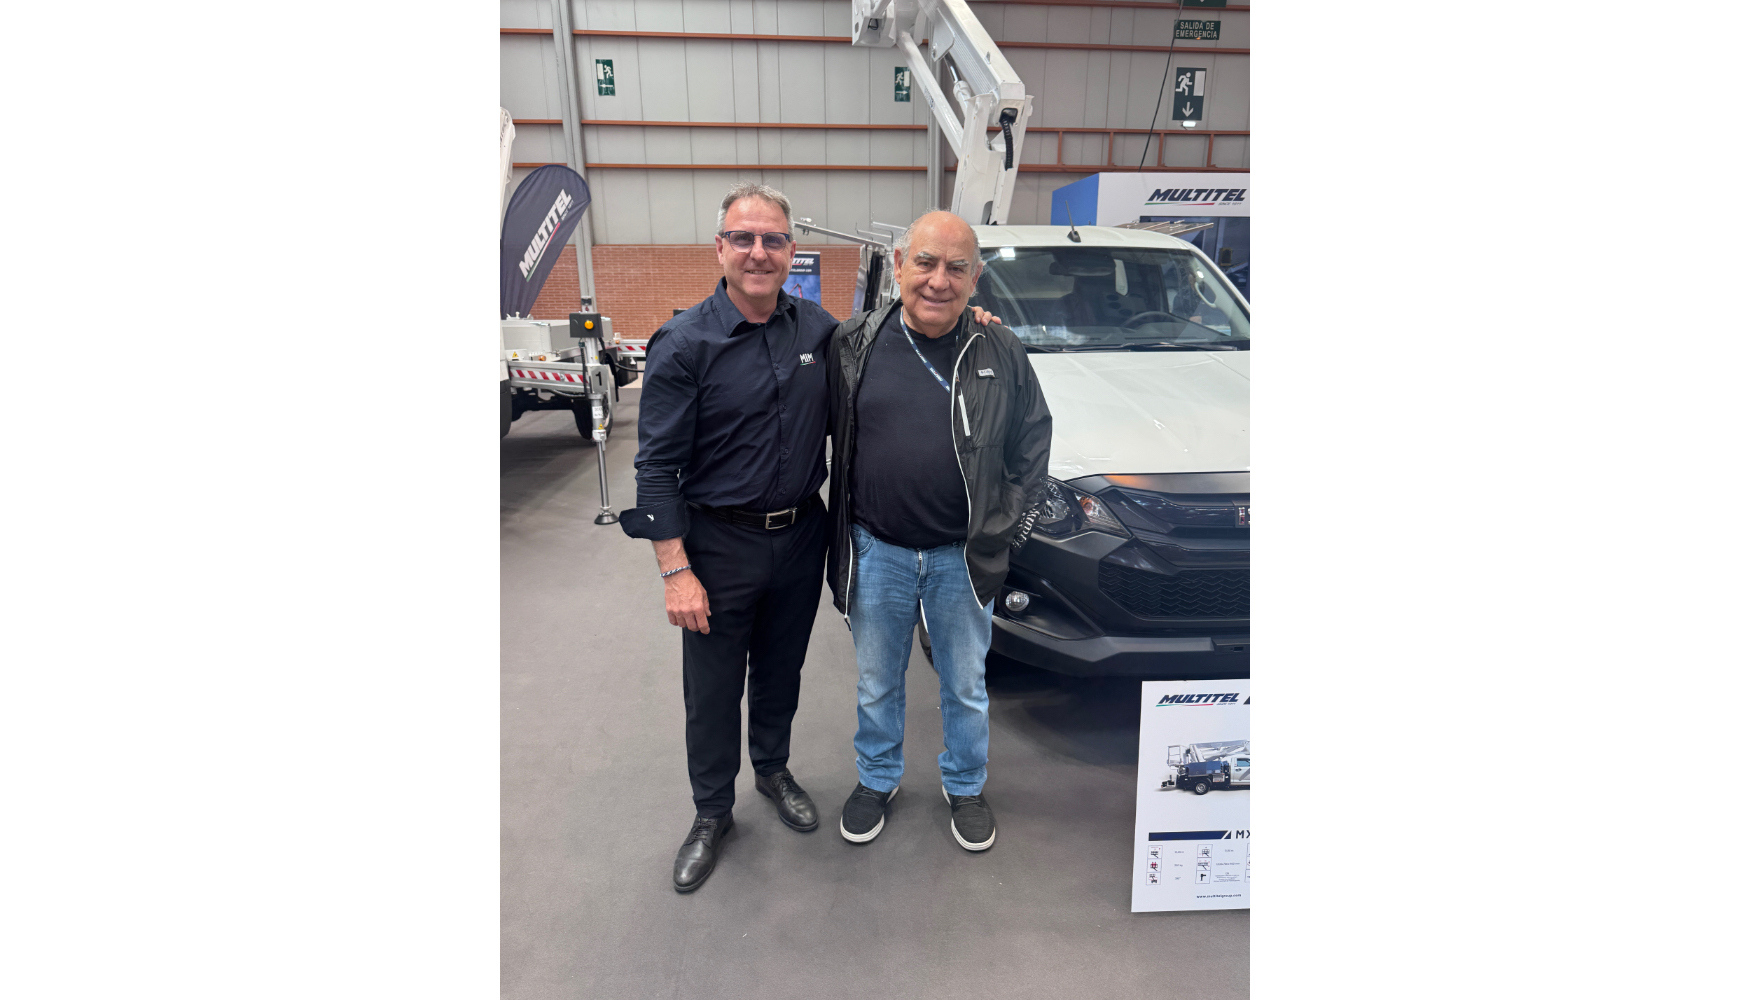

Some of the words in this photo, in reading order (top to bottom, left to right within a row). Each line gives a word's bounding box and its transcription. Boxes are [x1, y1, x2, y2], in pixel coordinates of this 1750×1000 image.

[1180, 21, 1204, 30] SALIDA
[1205, 22, 1215, 30] DE
[1175, 30, 1218, 38] EMERGENCIA
[1147, 188, 1247, 202] MULTITEL
[518, 188, 573, 278] MULTITEL
[595, 371, 603, 386] 1
[1158, 692, 1240, 705] MULTITEL
